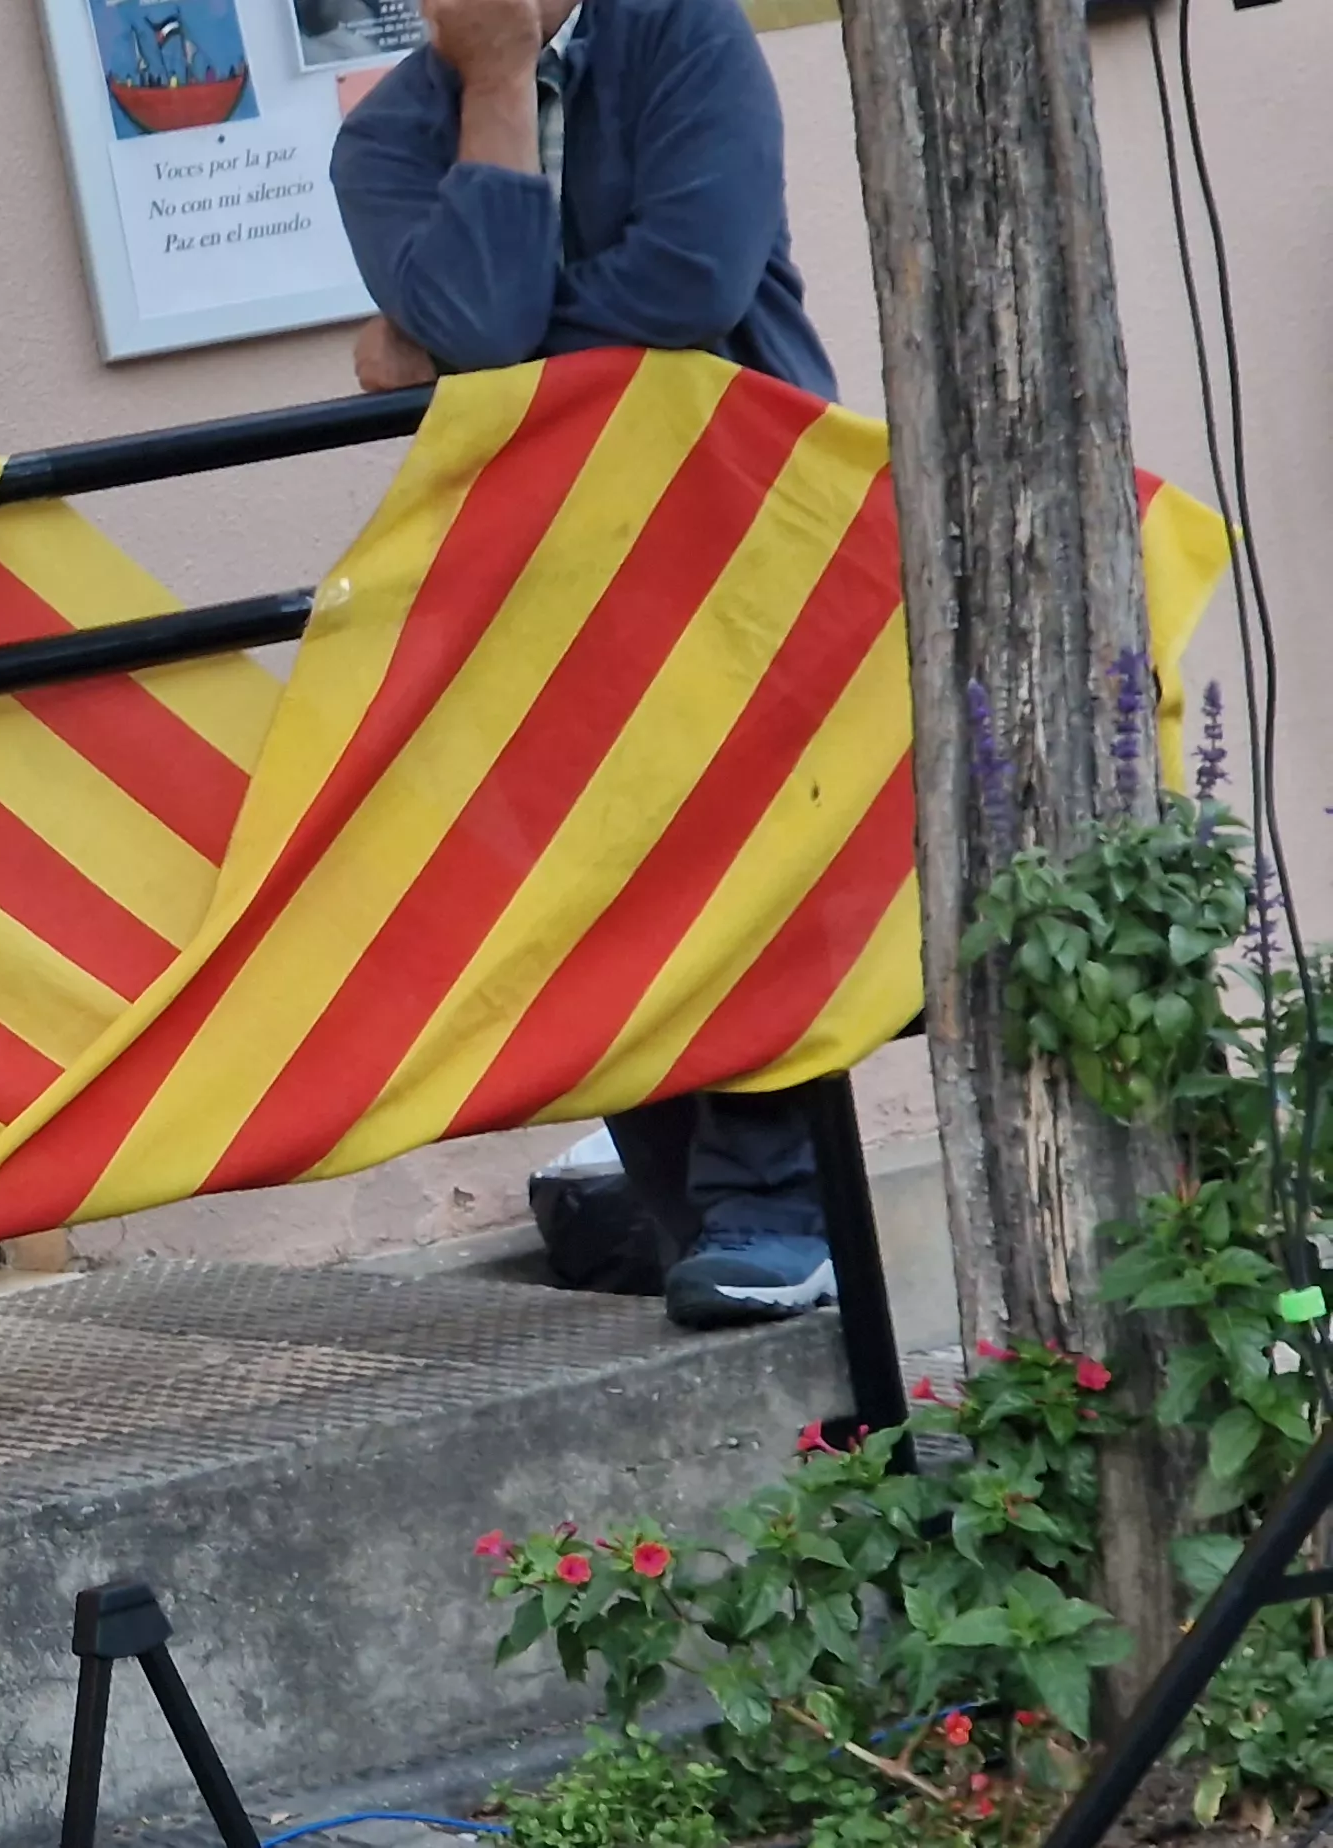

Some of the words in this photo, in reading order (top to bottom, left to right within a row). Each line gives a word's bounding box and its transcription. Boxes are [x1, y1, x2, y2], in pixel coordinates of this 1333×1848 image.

[154, 161, 204, 181] Voces
[209, 156, 240, 179] por
[244, 148, 260, 168] la
[265, 146, 297, 169] paz
[148, 198, 176, 220] No
[181, 195, 213, 215] con
[218, 184, 241, 208] mi
[246, 174, 314, 203] silencio
[164, 232, 195, 254] Paz
[199, 232, 221, 248] en
[226, 222, 242, 243] el
[247, 211, 312, 240] mundo
